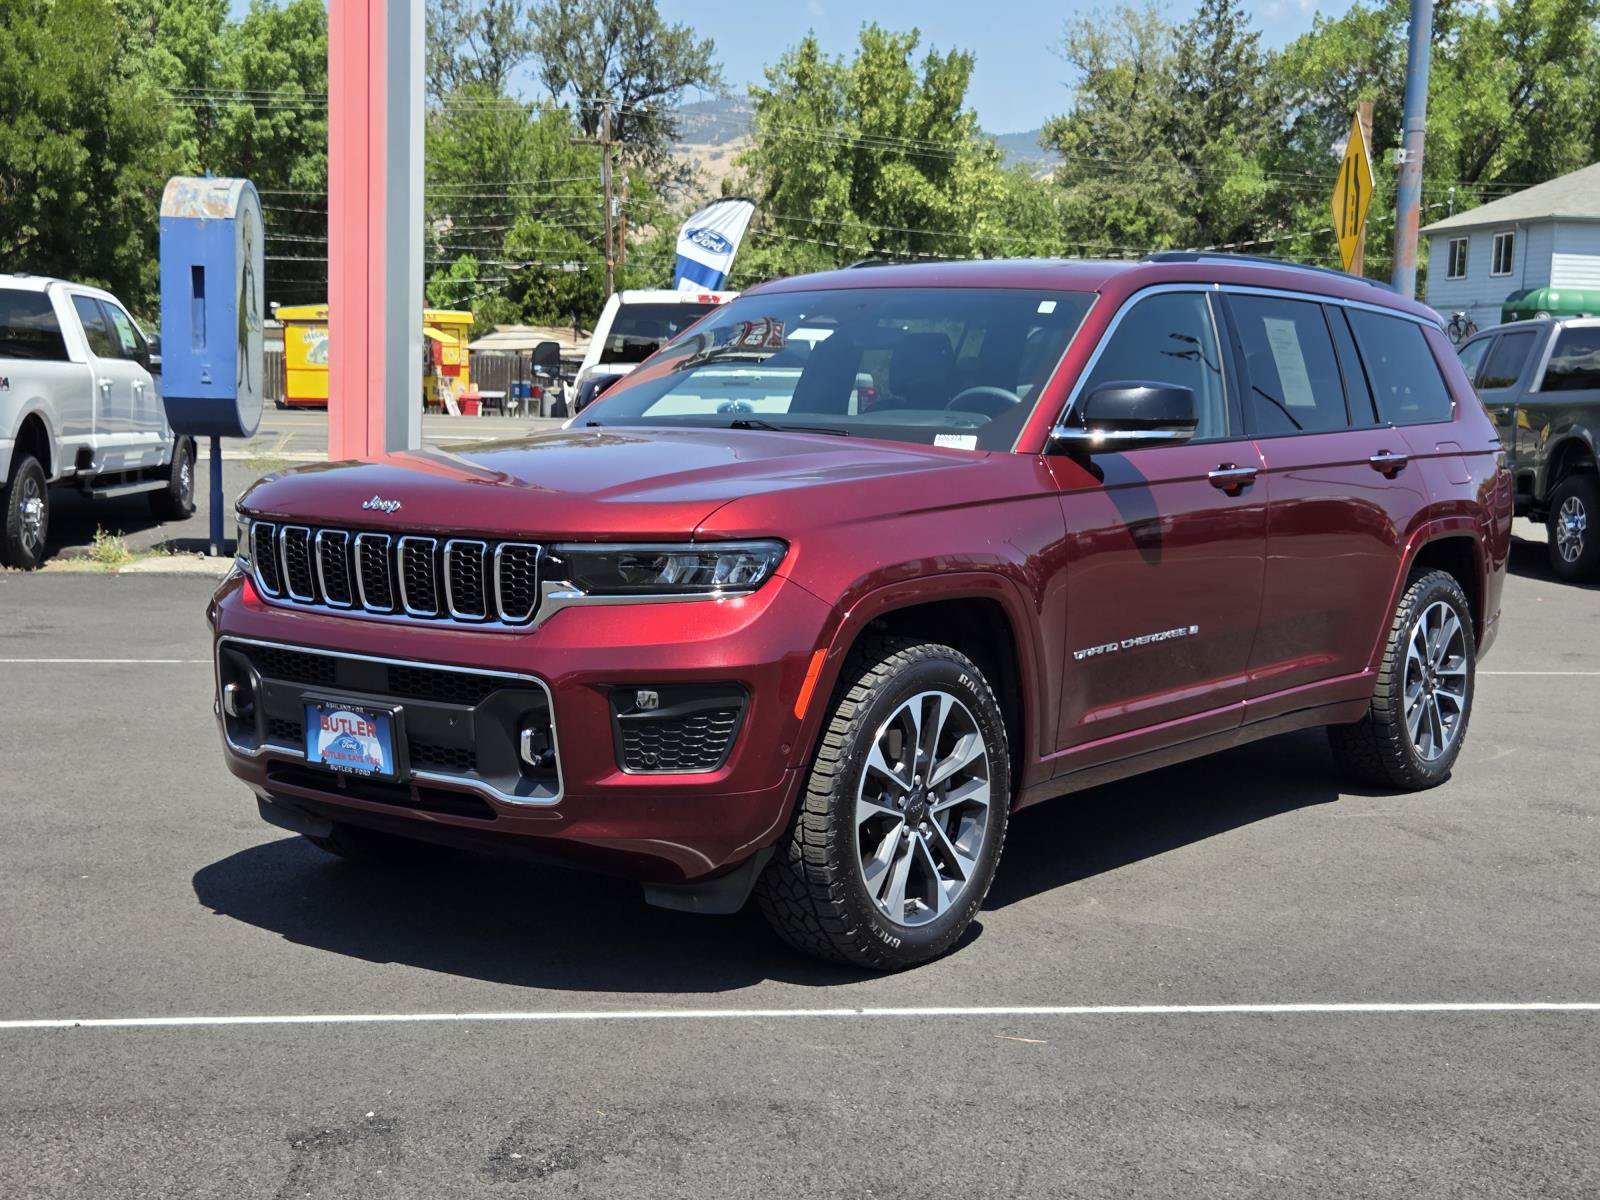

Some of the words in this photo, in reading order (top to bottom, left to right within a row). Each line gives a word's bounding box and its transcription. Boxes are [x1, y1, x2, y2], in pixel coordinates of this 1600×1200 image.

[692, 231, 726, 252] Ford
[362, 495, 401, 513] Jeep
[1073, 642, 1119, 660] GRAND
[1121, 627, 1188, 649] CHEROKEE
[320, 716, 377, 738] BUTLER
[341, 740, 358, 750] Ford
[330, 765, 353, 774] BUTLER
[355, 768, 371, 777] FORD
